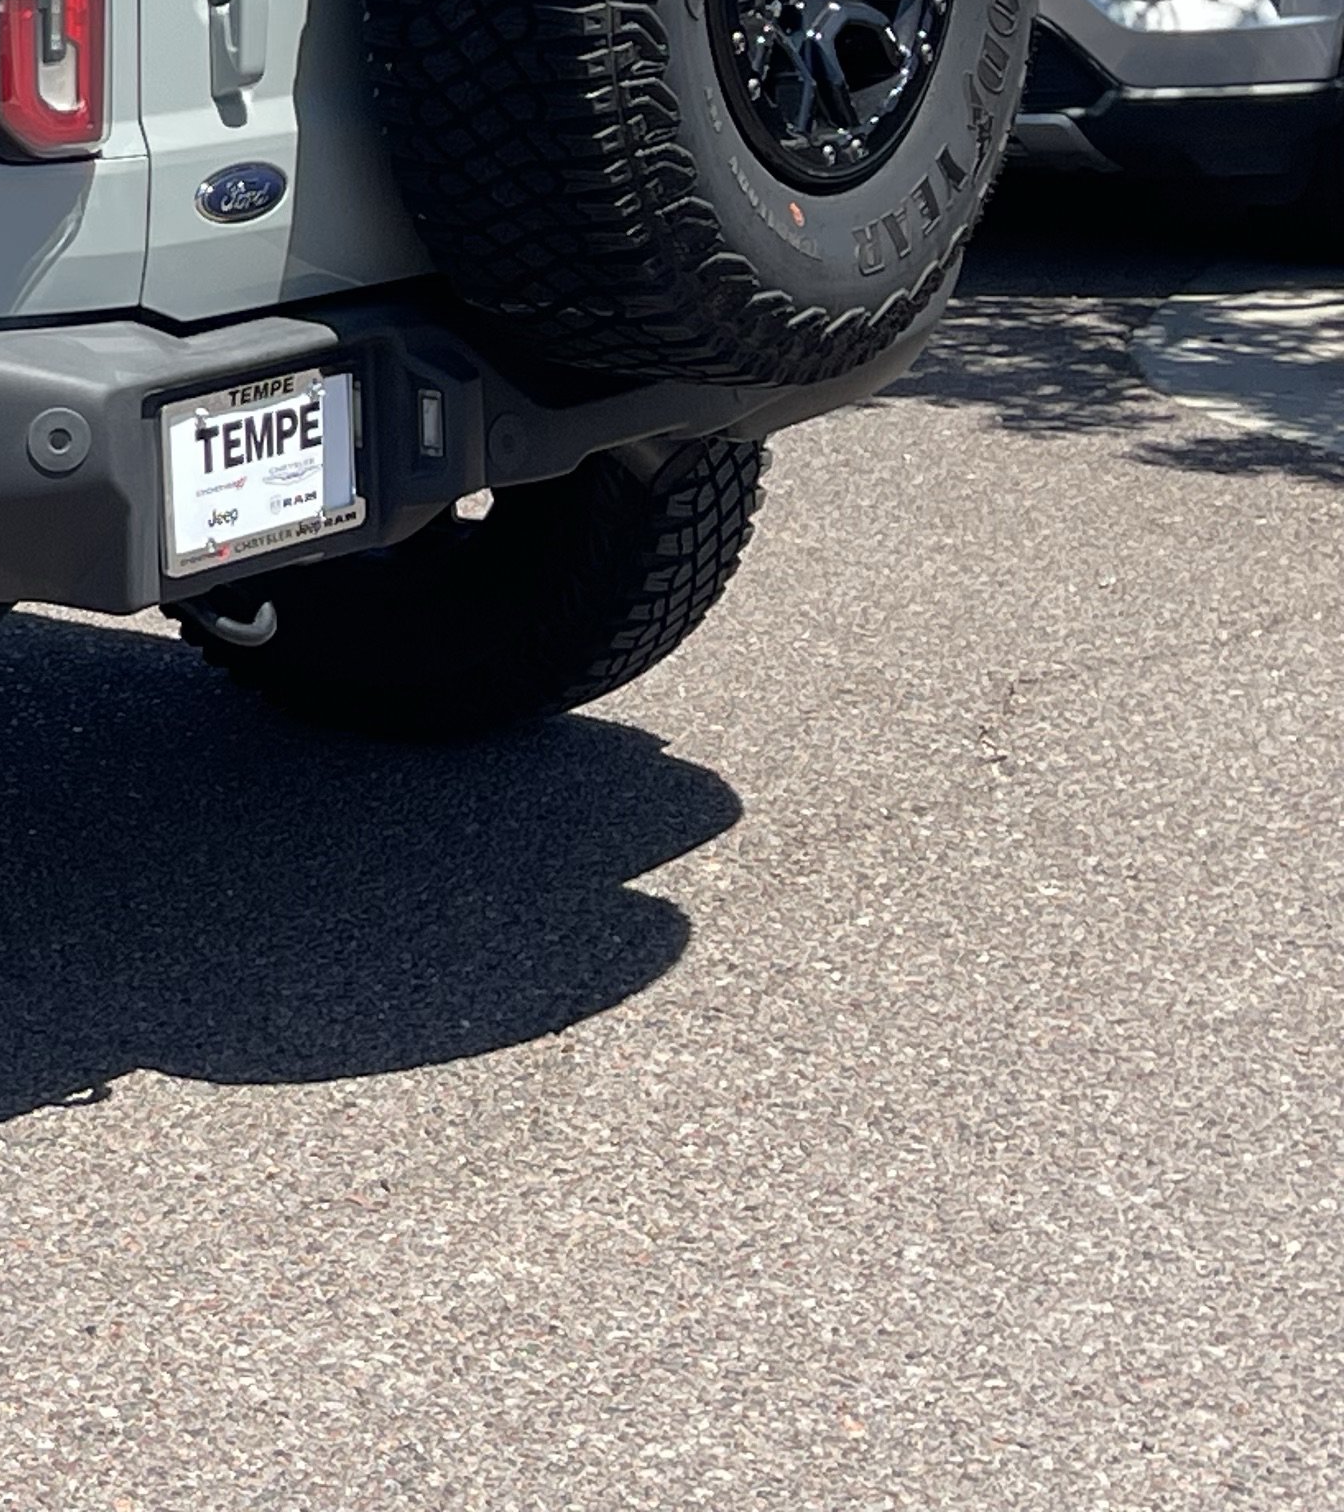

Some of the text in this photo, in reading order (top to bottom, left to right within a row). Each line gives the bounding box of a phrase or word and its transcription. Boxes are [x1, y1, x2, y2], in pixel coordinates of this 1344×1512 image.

[220, 180, 272, 212] Ford
[228, 376, 294, 407] TEMPE
[194, 400, 323, 474] TEMPE
[282, 490, 318, 508] RAM
[208, 508, 239, 528] Jeep
[324, 511, 357, 529] RAM
